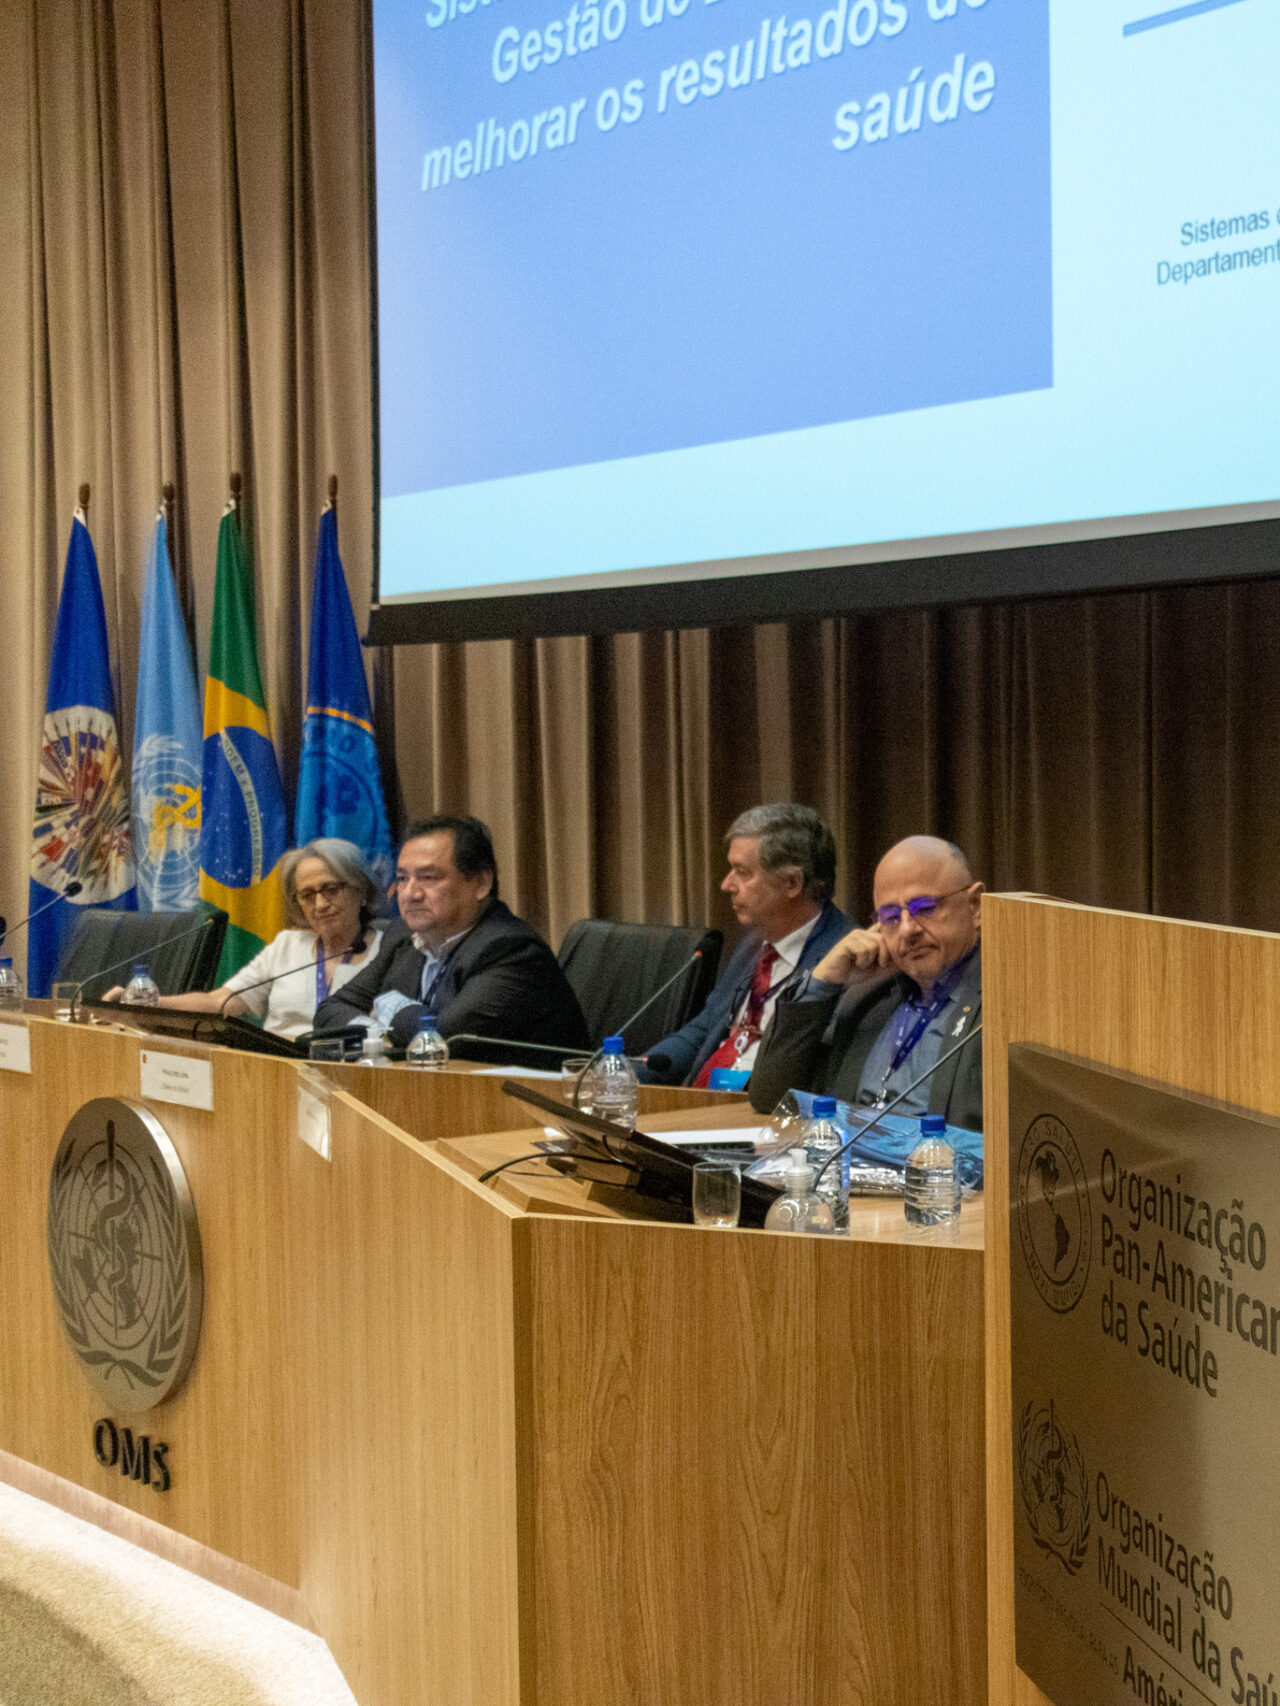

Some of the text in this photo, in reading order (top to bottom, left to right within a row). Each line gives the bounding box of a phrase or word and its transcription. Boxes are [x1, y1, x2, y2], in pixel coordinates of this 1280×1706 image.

[422, 0, 908, 192] melhorar os resultados
[492, 0, 626, 84] Gestão
[832, 53, 995, 151] saúde
[1180, 209, 1270, 246] Sistemas
[1100, 1147, 1267, 1275] Organização
[1101, 1279, 1219, 1399] da Saúde
[93, 1418, 171, 1493] OMS
[1096, 1470, 1234, 1621] Organização
[1098, 1535, 1184, 1654] Mundial
[1191, 1615, 1222, 1688] da
